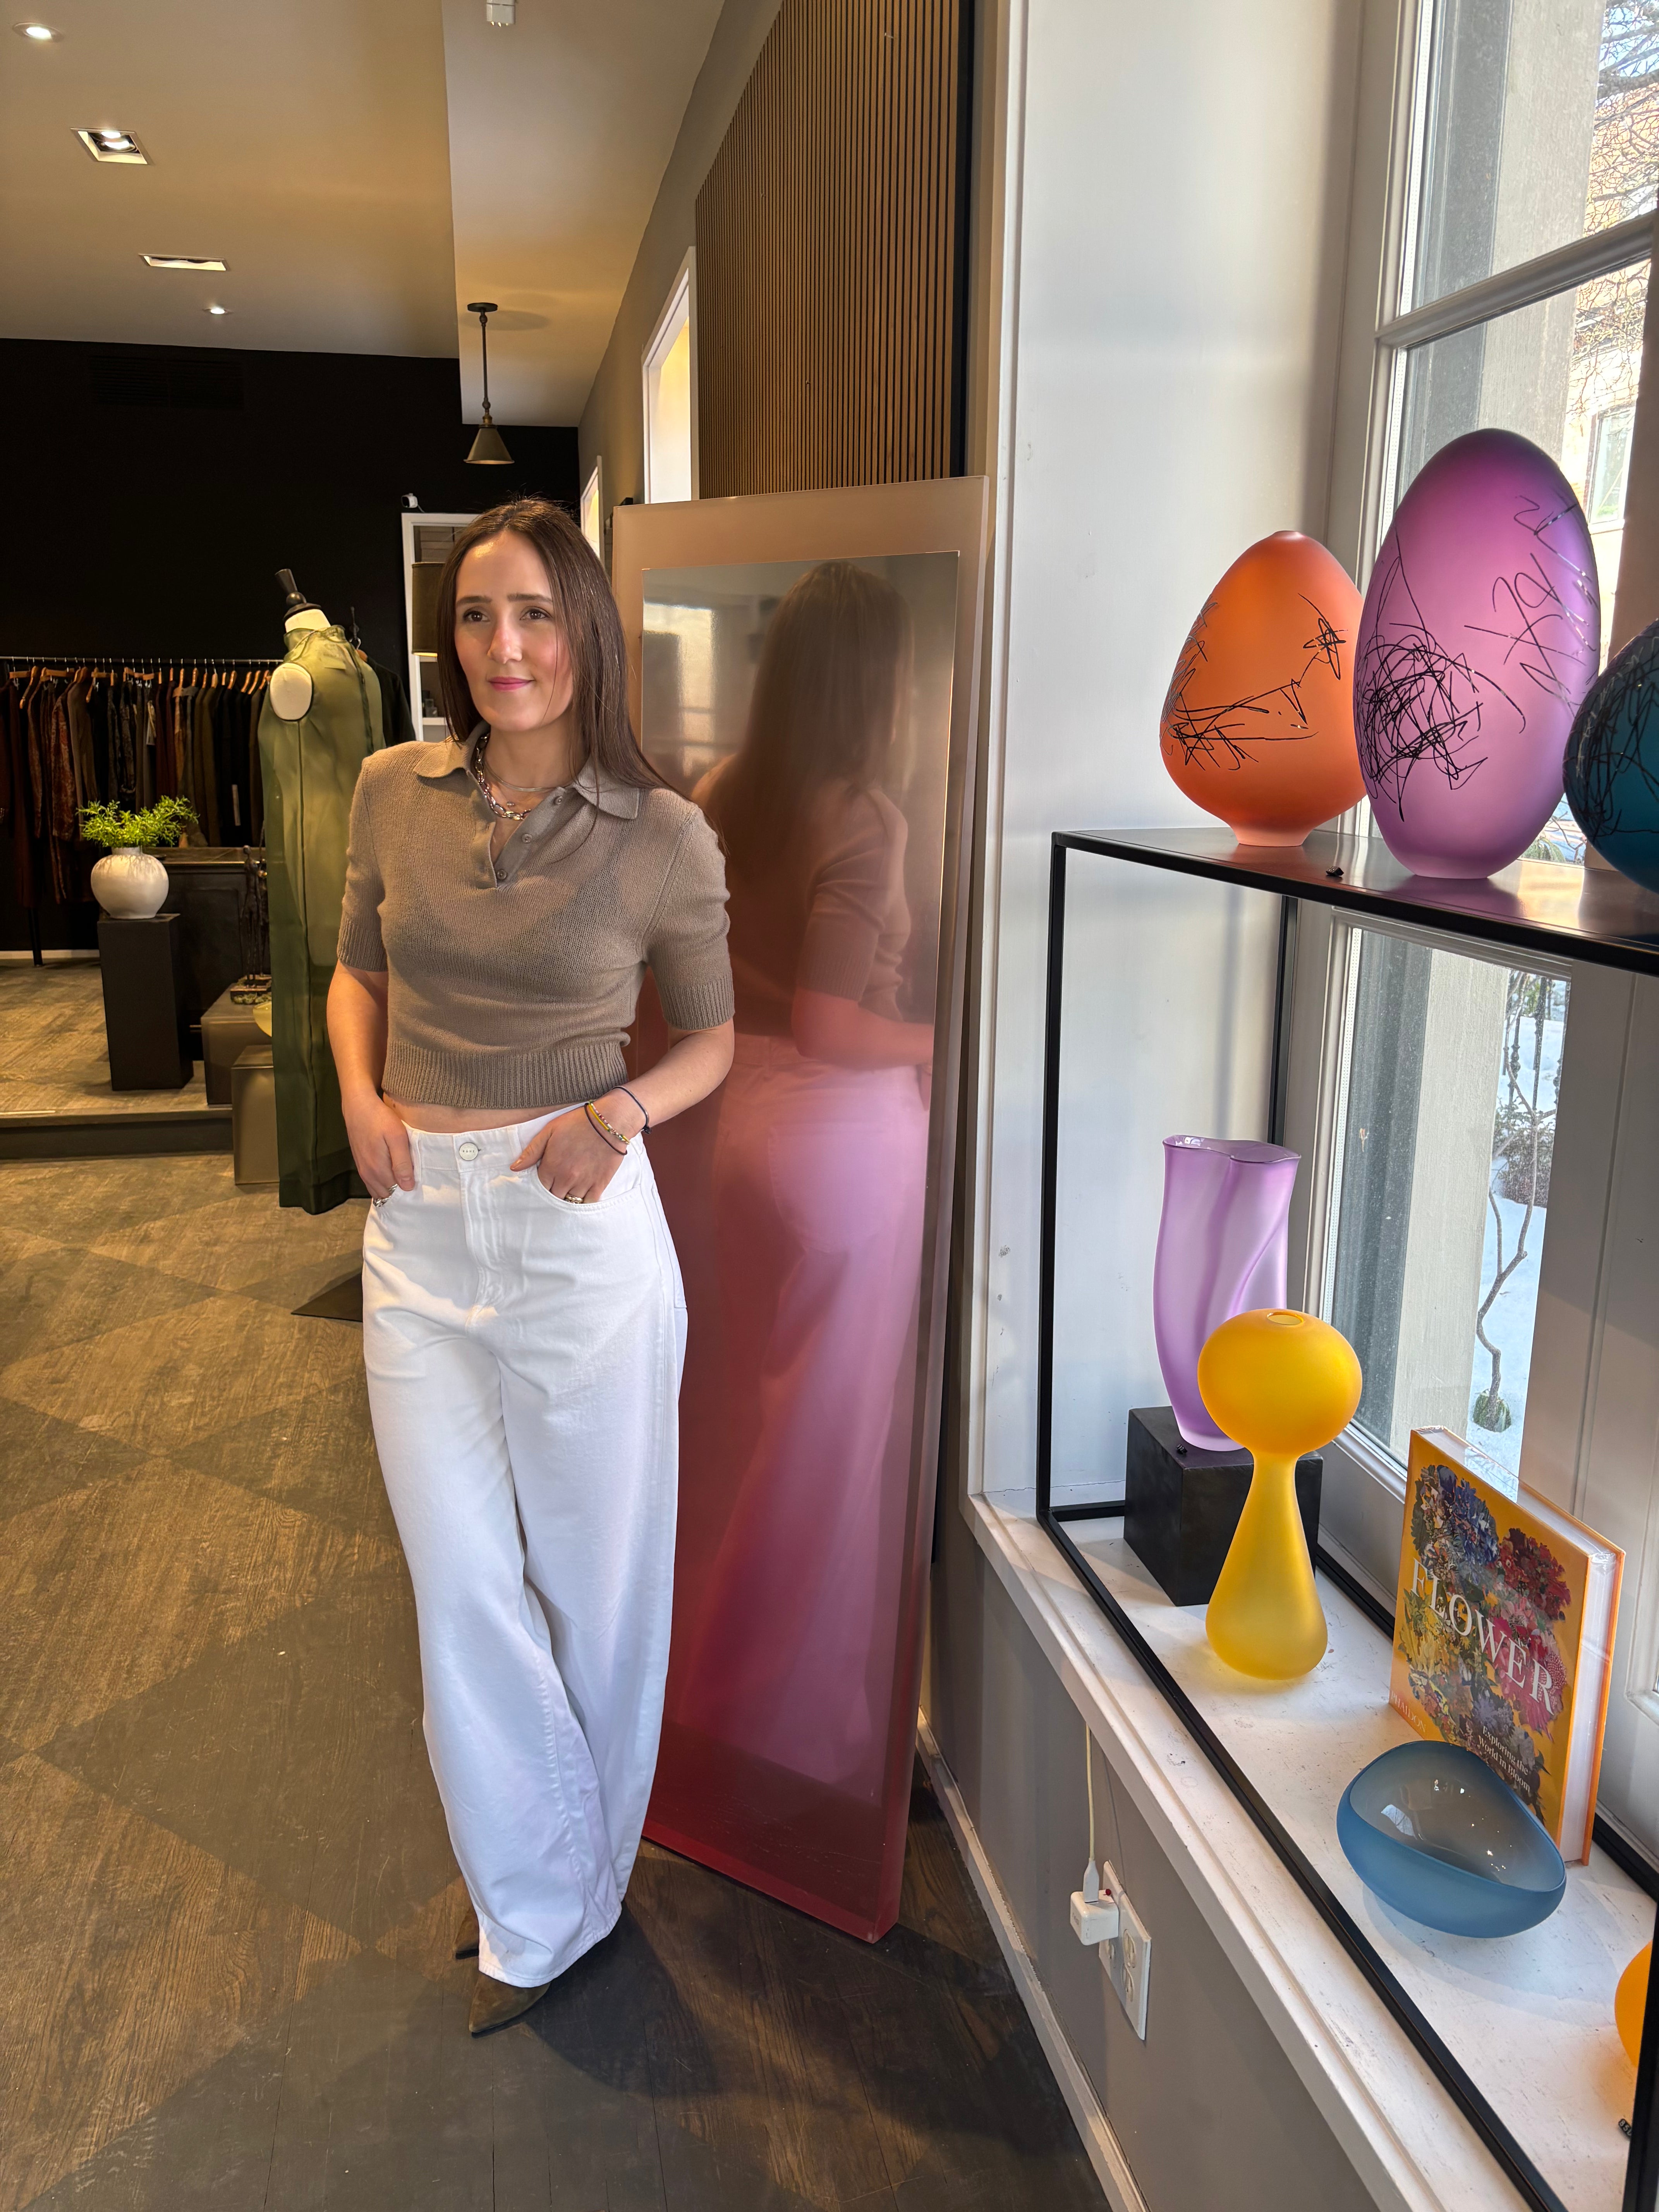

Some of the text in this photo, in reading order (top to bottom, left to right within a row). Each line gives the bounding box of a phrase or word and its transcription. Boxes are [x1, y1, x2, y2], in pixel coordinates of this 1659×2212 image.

[1411, 1558, 1554, 1716] FLOWER
[1391, 1690, 1426, 1733] PHAIDON
[1478, 1735, 1530, 1793] World in Bloom
[1483, 1725, 1528, 1776] Exploring the
